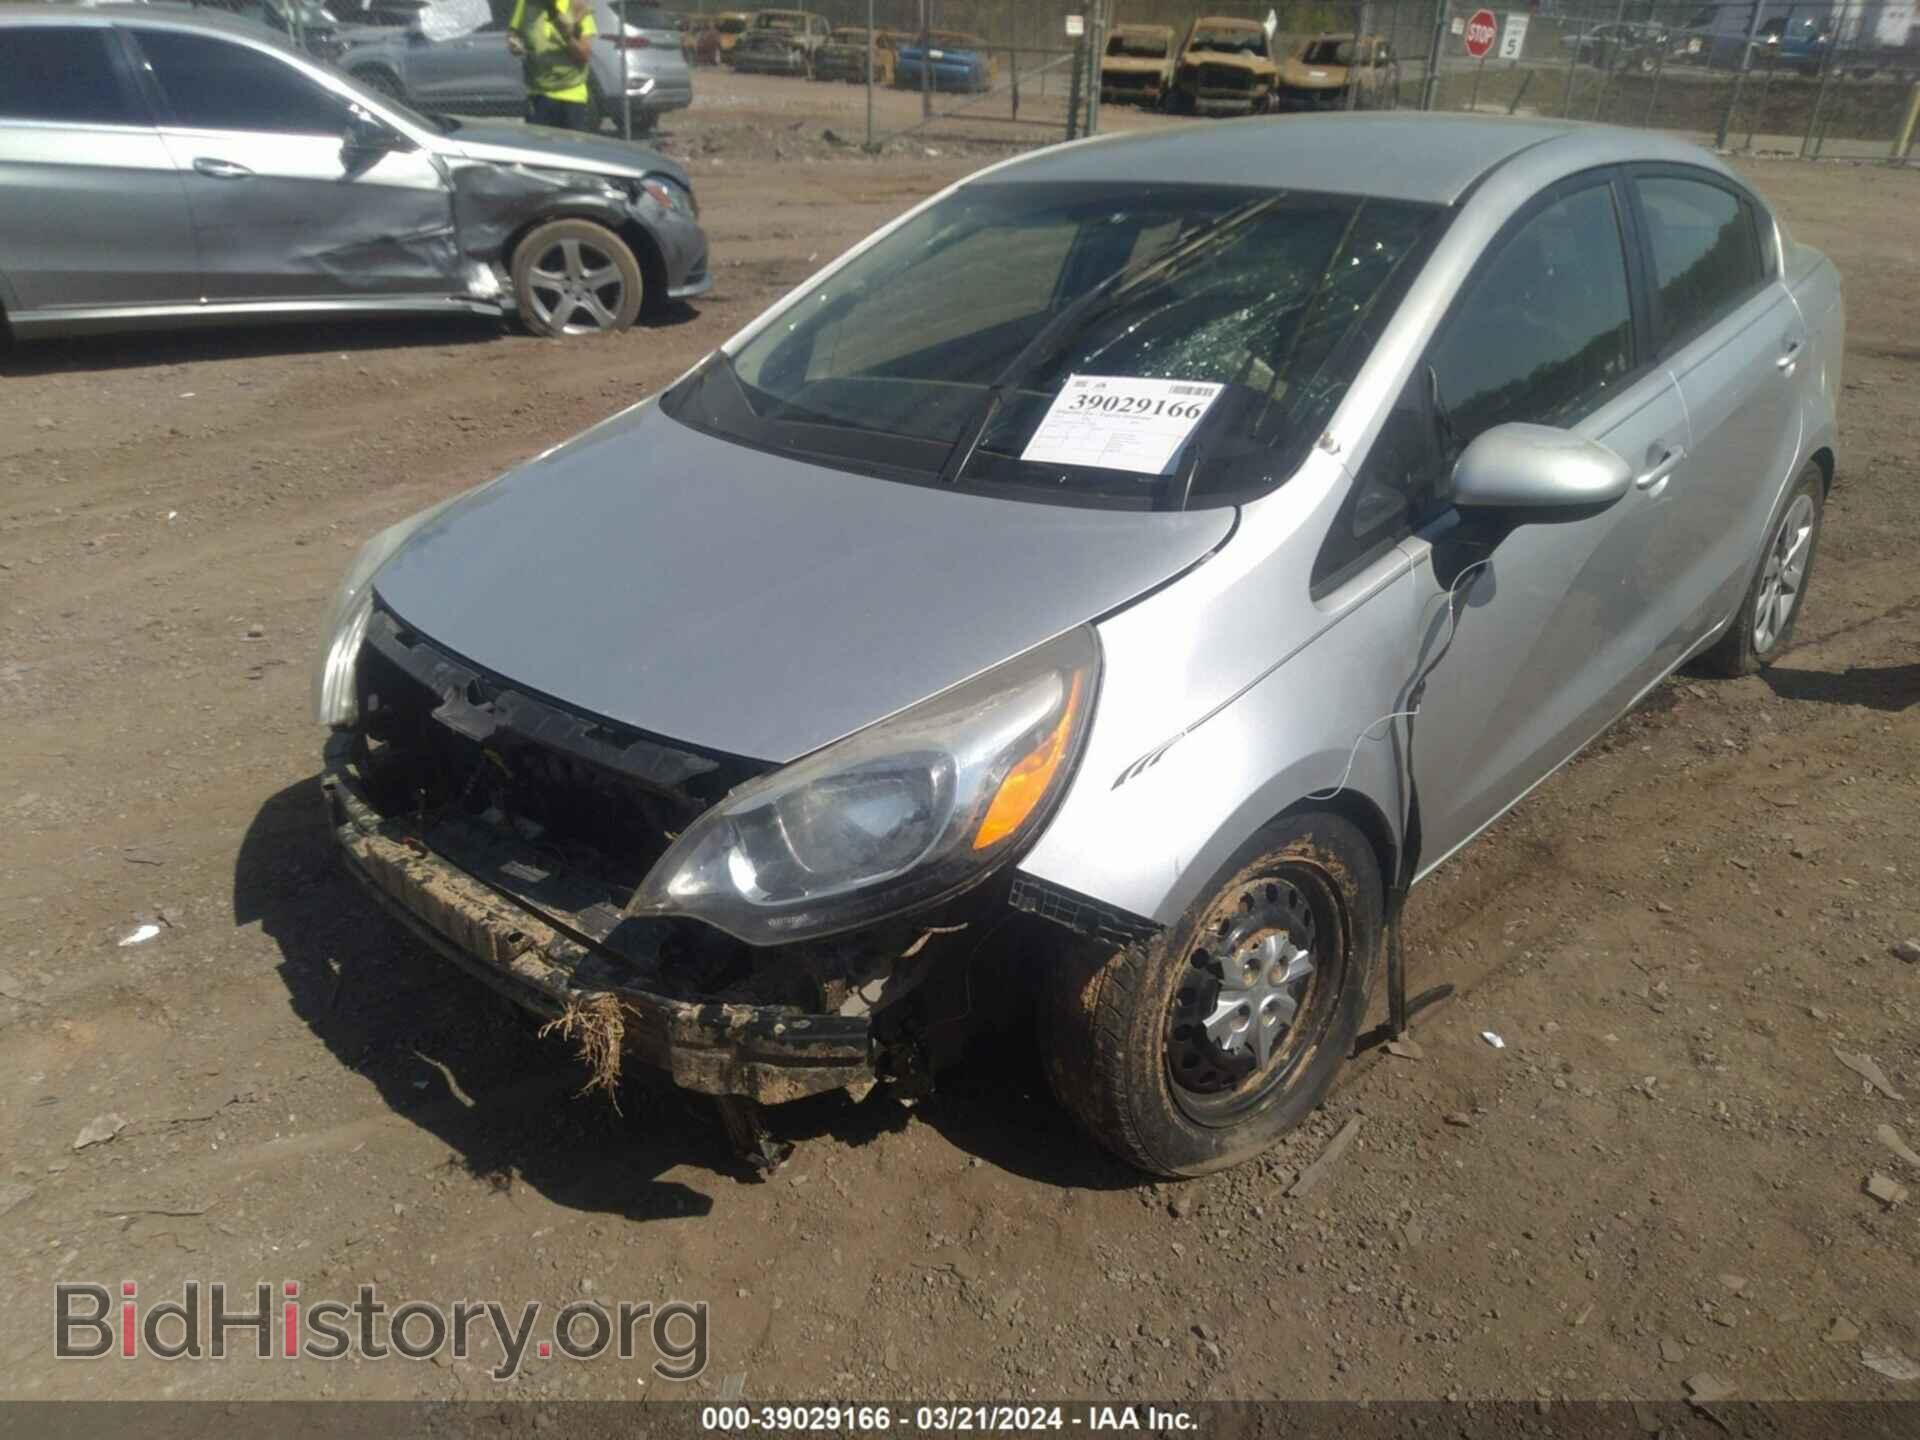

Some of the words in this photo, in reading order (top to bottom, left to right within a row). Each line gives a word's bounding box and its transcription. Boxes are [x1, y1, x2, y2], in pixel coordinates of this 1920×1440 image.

[1467, 23, 1496, 43] STOP
[1506, 38, 1517, 55] 5
[1069, 394, 1202, 419] 39029166
